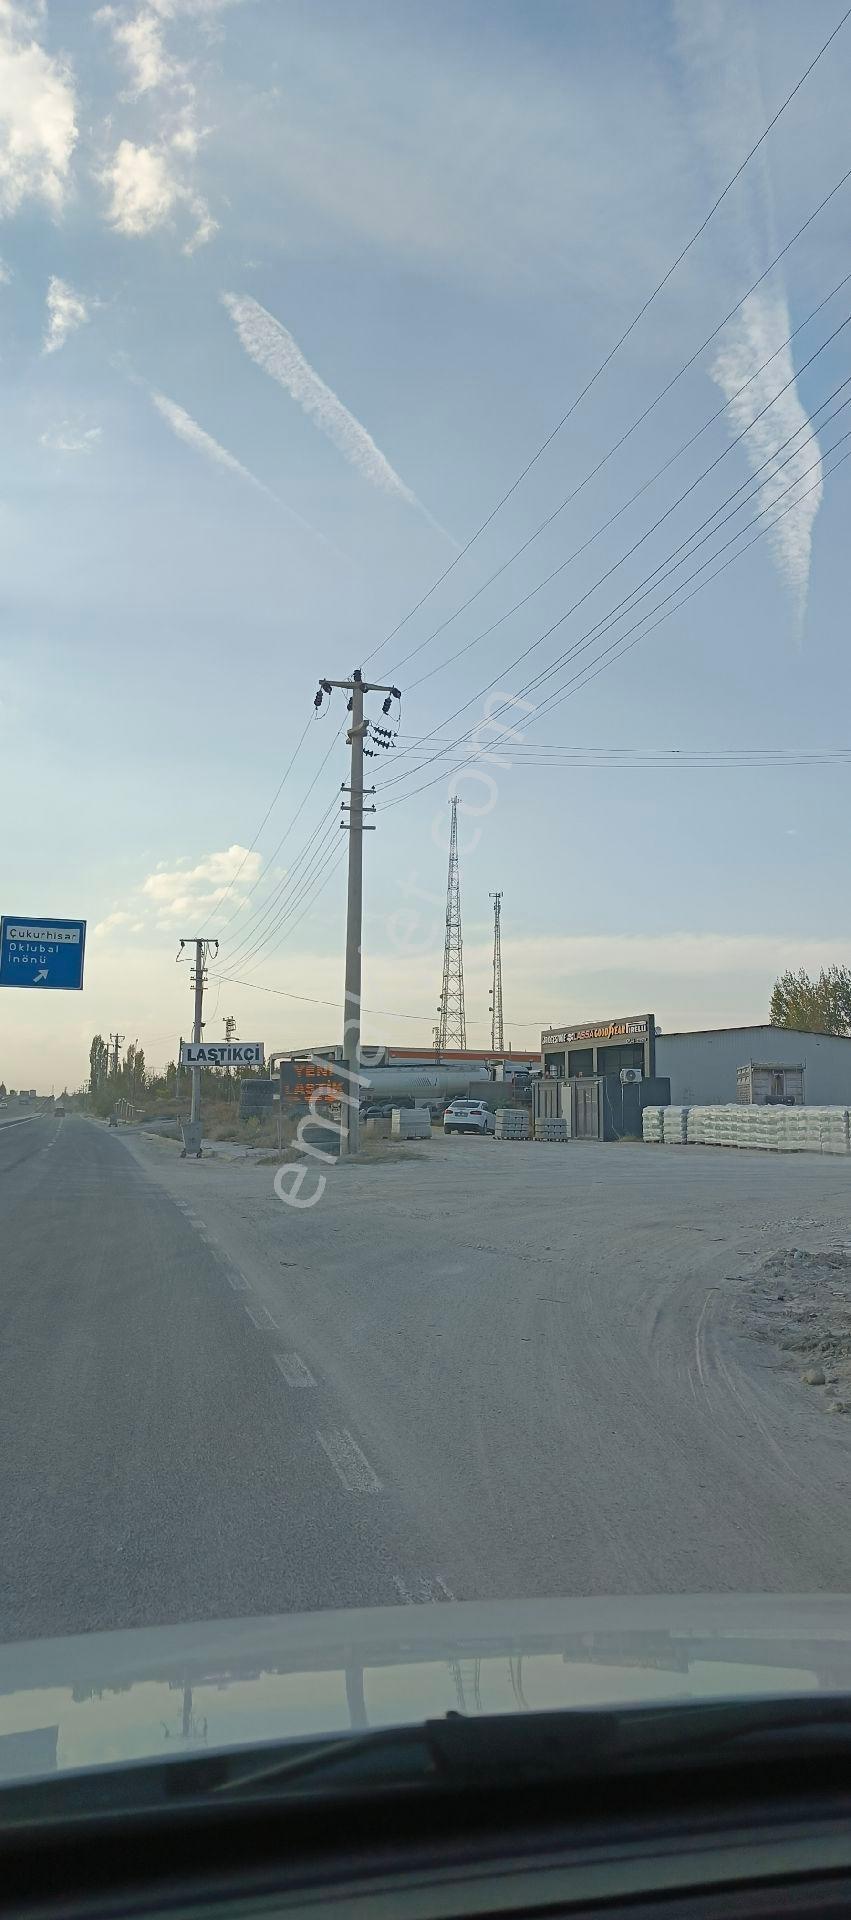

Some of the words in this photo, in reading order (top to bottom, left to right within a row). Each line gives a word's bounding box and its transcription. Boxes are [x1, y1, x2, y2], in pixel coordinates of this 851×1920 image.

[9, 928, 77, 941] Çukurhisar
[9, 943, 59, 953] Oklubal
[8, 952, 47, 964] İnönü
[573, 1029, 593, 1041] LASSA
[593, 1022, 626, 1039] GOODYEAR
[625, 1021, 647, 1034] PIRELLI
[187, 1043, 260, 1065] LASTİKÇİ
